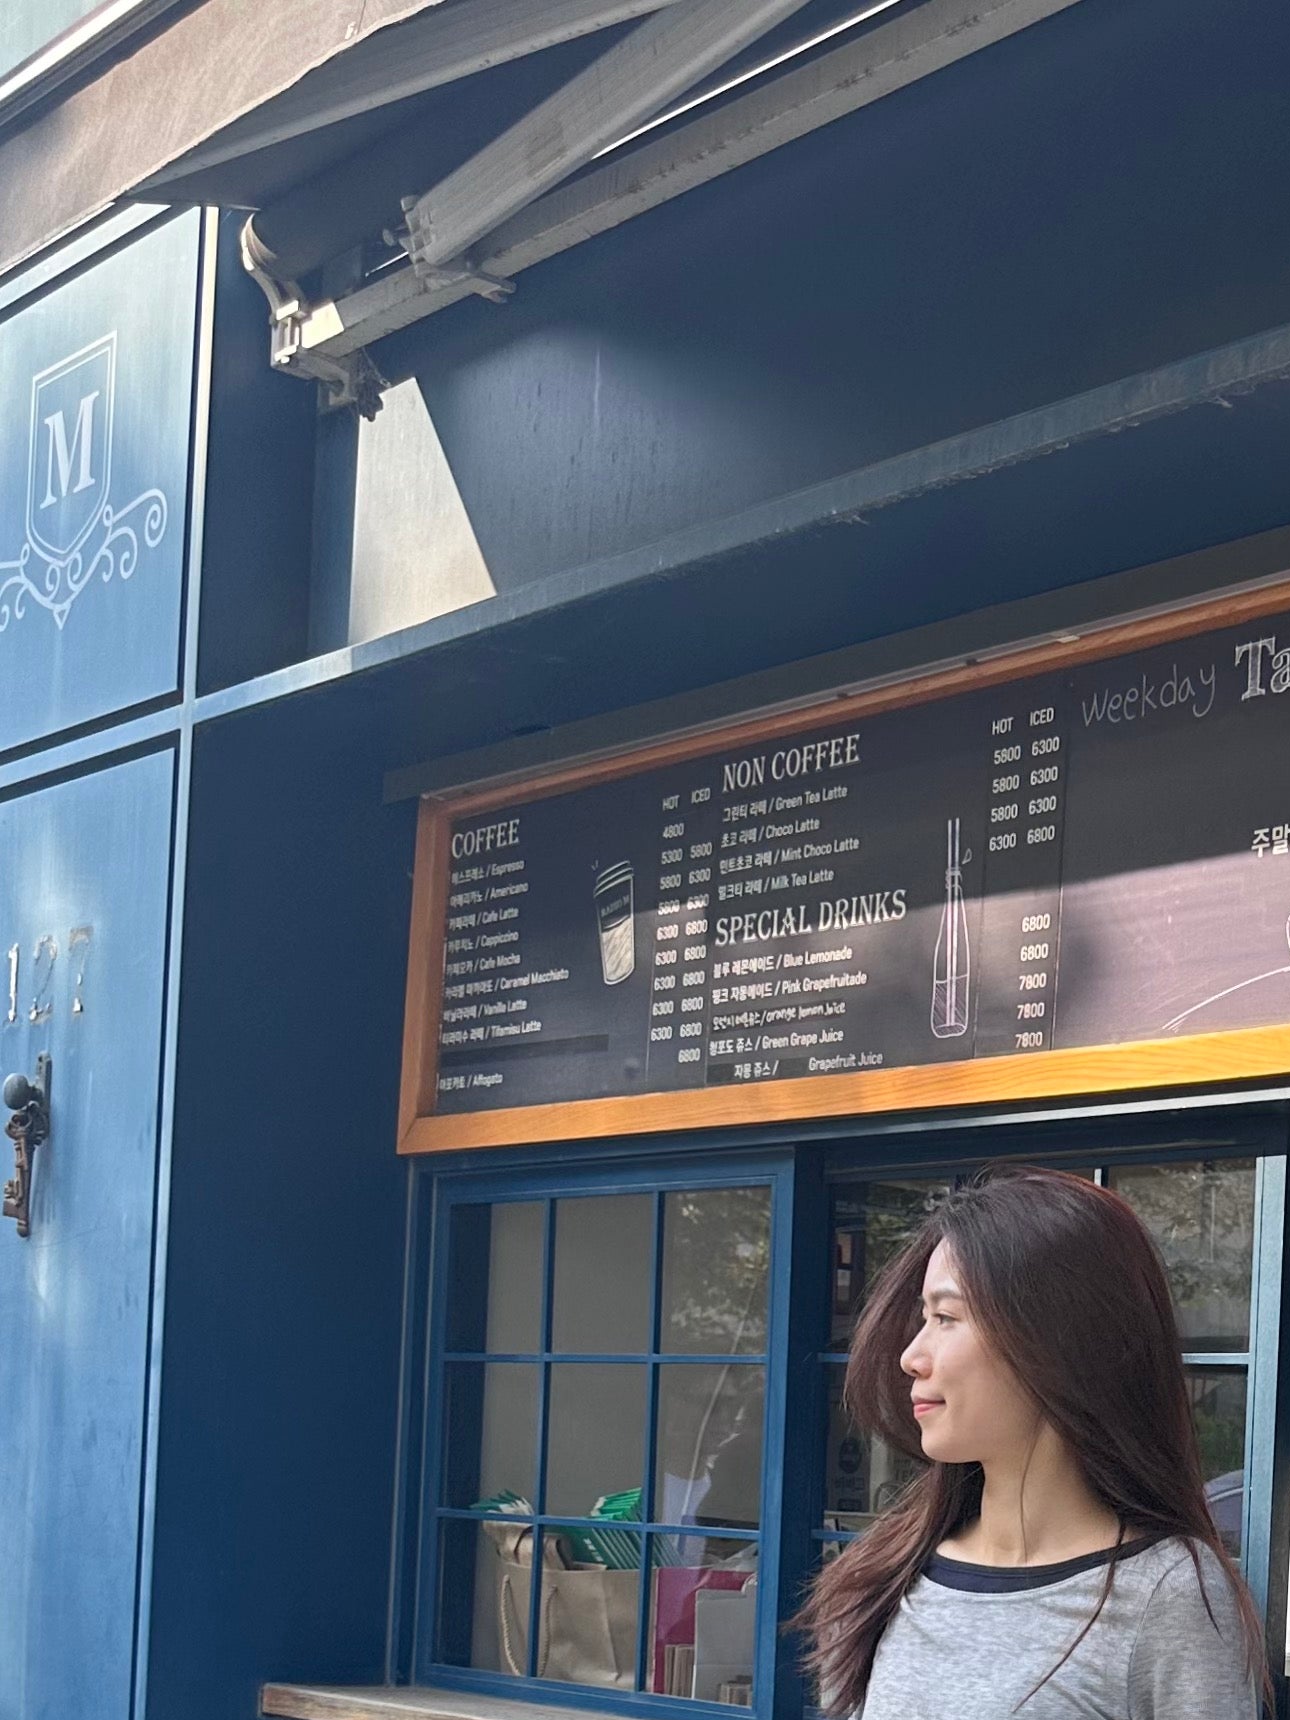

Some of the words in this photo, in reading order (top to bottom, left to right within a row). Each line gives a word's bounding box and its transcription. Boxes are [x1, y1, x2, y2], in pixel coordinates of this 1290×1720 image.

[39, 390, 99, 509] M
[991, 716, 1014, 735] HOT
[1029, 707, 1055, 727] ICED
[993, 745, 1021, 765] 5800
[1031, 736, 1060, 757] 6300
[721, 756, 766, 793] NON
[771, 734, 861, 780] COFFEE
[992, 774, 1020, 794] 5800
[1030, 766, 1059, 786] 6300
[662, 795, 680, 811] HOT
[690, 787, 711, 804] ICED
[775, 795, 803, 811] Green
[804, 790, 821, 804] Tea
[822, 785, 848, 801] Latte
[990, 803, 1018, 823] 5800
[1028, 795, 1057, 815] 6300
[452, 818, 520, 859] COFFEE
[765, 823, 794, 840] Choco
[795, 818, 820, 833] Latte
[989, 832, 1017, 852] 6300
[1027, 825, 1055, 845] 6800
[1251, 823, 1290, 858] 주말
[781, 846, 802, 862] Mint
[803, 843, 832, 858] Choco
[834, 837, 860, 854] Latte
[688, 868, 711, 885] 6300
[771, 875, 790, 890] Milk
[791, 873, 807, 887] Tea
[808, 868, 835, 884] Latte
[715, 904, 812, 947] SPECIAL
[818, 889, 907, 932] DRINKS
[1021, 913, 1051, 933] 6800
[783, 953, 803, 968] Blue
[805, 946, 853, 966] Lemonade
[1020, 943, 1049, 962] 6800
[781, 979, 802, 995] Pink
[803, 971, 868, 993] Grapefruitade
[1018, 972, 1047, 991] 7800
[1016, 1002, 1045, 1020] 7800
[761, 1035, 789, 1050] Green
[790, 1031, 818, 1048] Grape
[819, 1027, 844, 1044] Juice
[1014, 1031, 1043, 1050] 7800
[808, 1053, 856, 1074] Grapefruit
[857, 1051, 884, 1068] Juice
